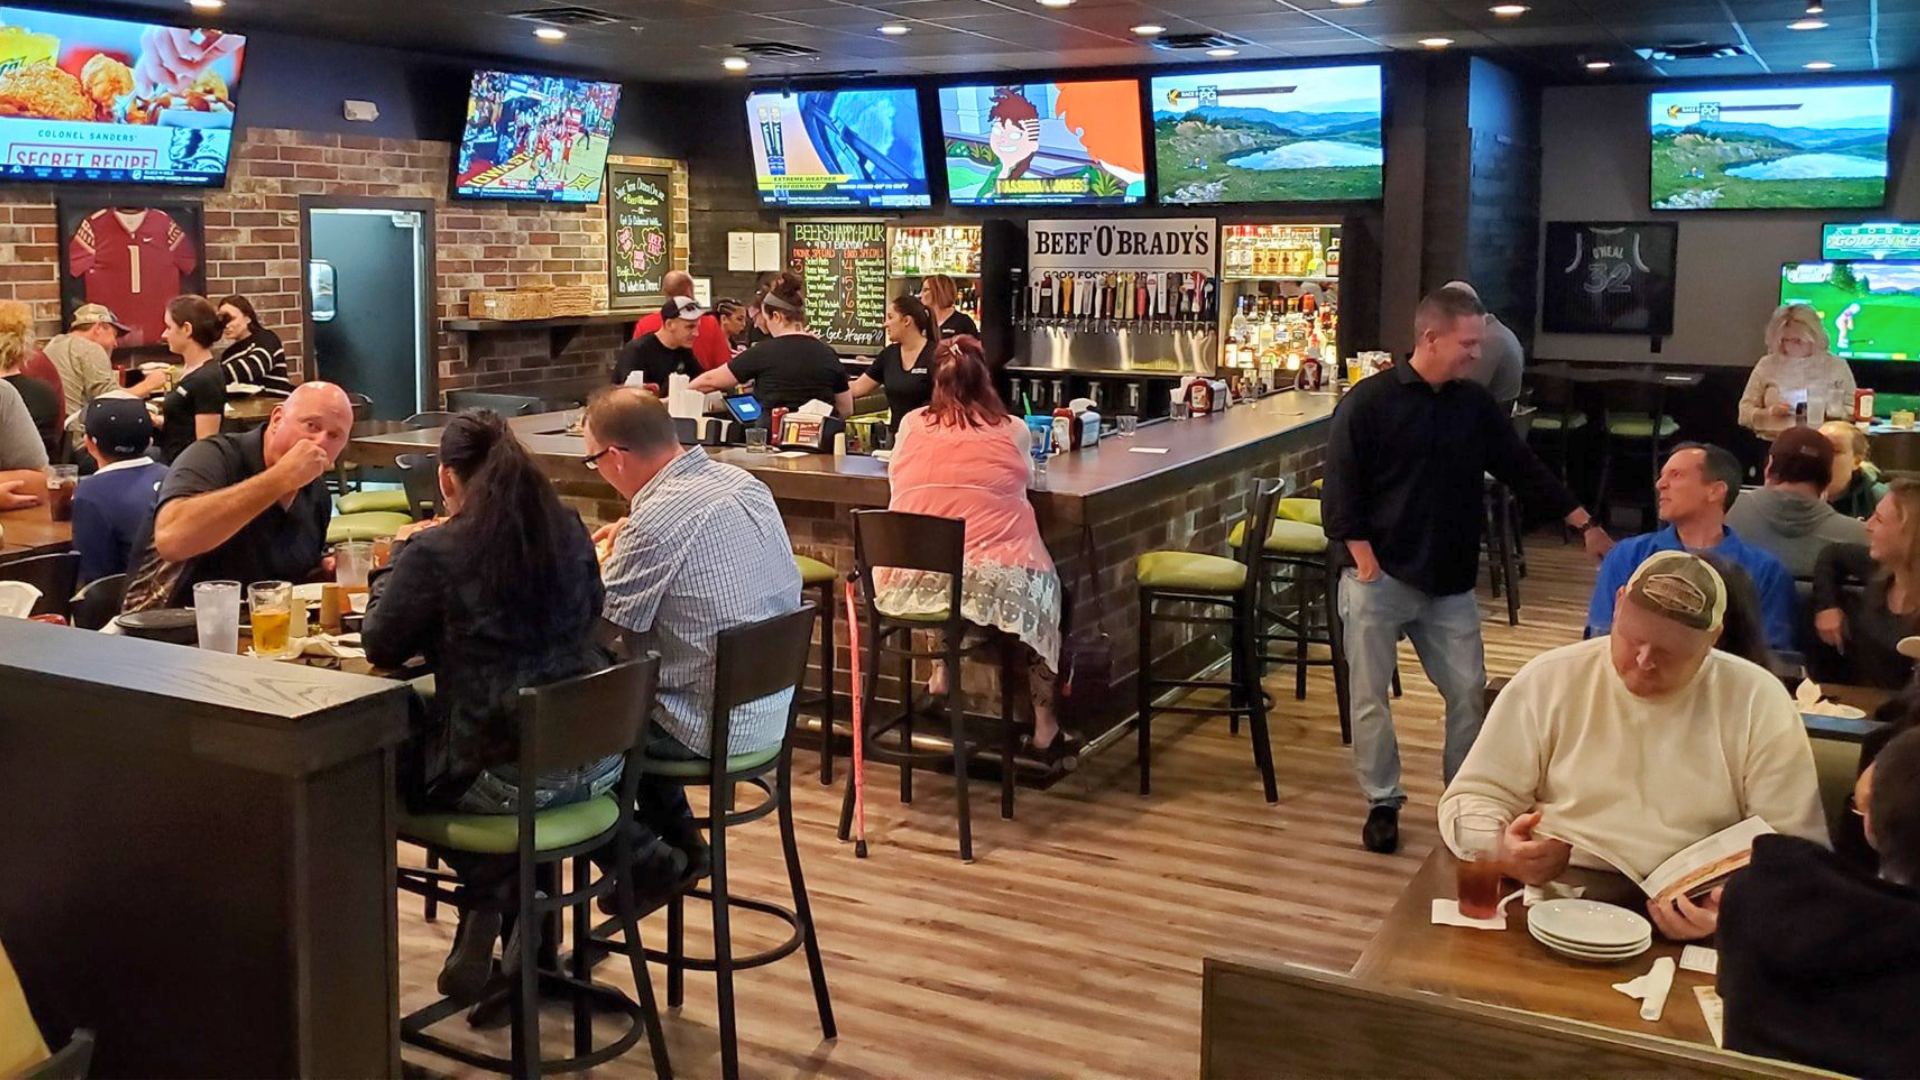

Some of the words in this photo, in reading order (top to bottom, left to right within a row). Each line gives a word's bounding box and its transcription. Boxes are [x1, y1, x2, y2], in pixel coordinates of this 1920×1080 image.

[1199, 91, 1217, 101] PG
[37, 129, 84, 140] COLONEL
[16, 151, 85, 167] SECRET
[91, 154, 150, 169] RECIPE
[466, 165, 509, 187] IOWA
[858, 225, 885, 242] HOUR
[1034, 231, 1092, 255] BEEF
[1116, 224, 1209, 255] BRADY'S
[1836, 235, 1894, 249] GOLDEN
[1592, 246, 1624, 259] O'NEAL
[127, 245, 141, 293] 1
[1043, 271, 1075, 280] GOOD
[1583, 263, 1632, 293] 32
[826, 327, 843, 343] Get
